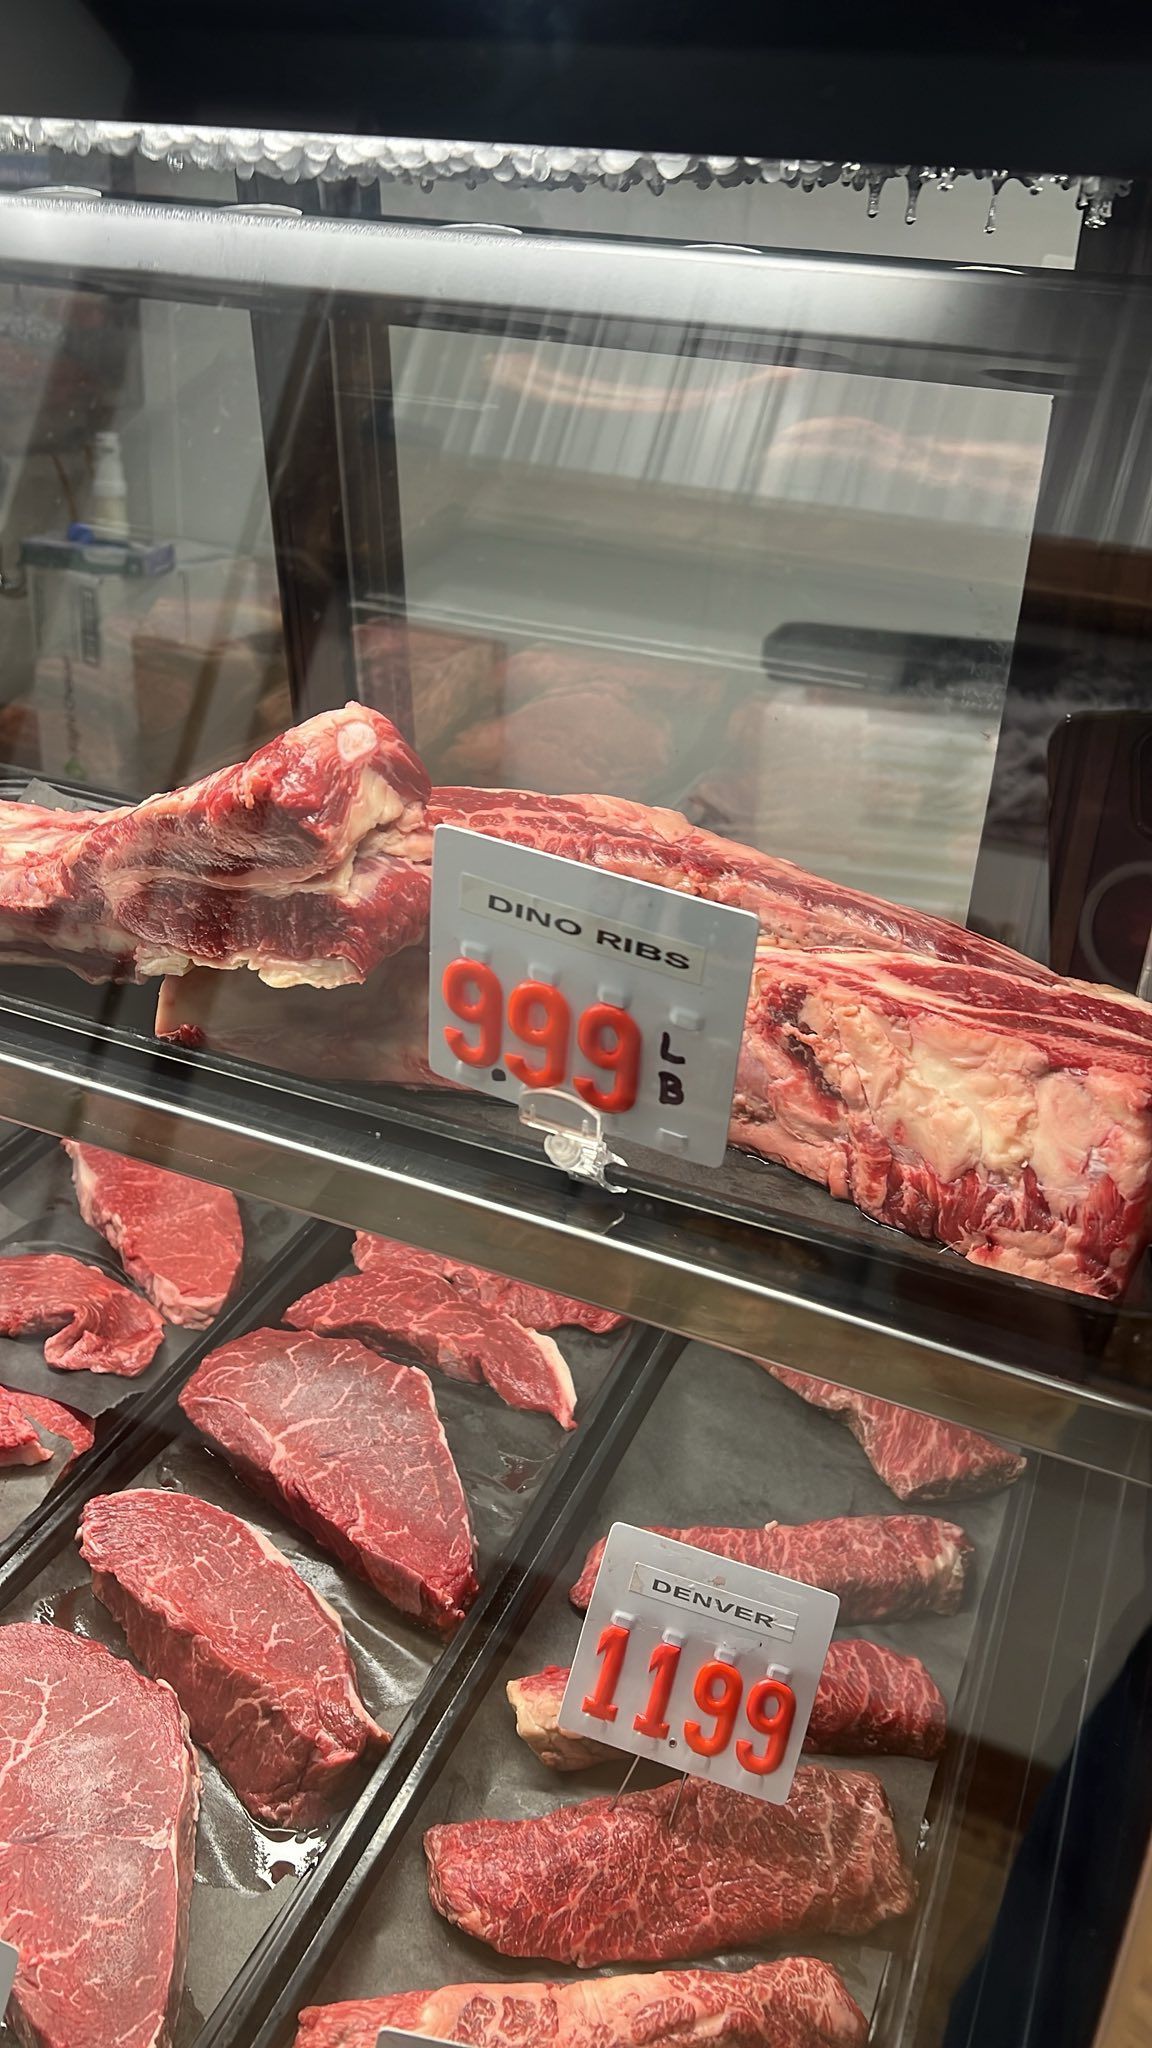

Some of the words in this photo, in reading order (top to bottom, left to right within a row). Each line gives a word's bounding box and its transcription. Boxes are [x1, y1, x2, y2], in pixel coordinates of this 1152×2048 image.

[488, 894, 582, 936] DINO
[595, 929, 690, 971] RIBS
[652, 1578, 774, 1628] DENVER
